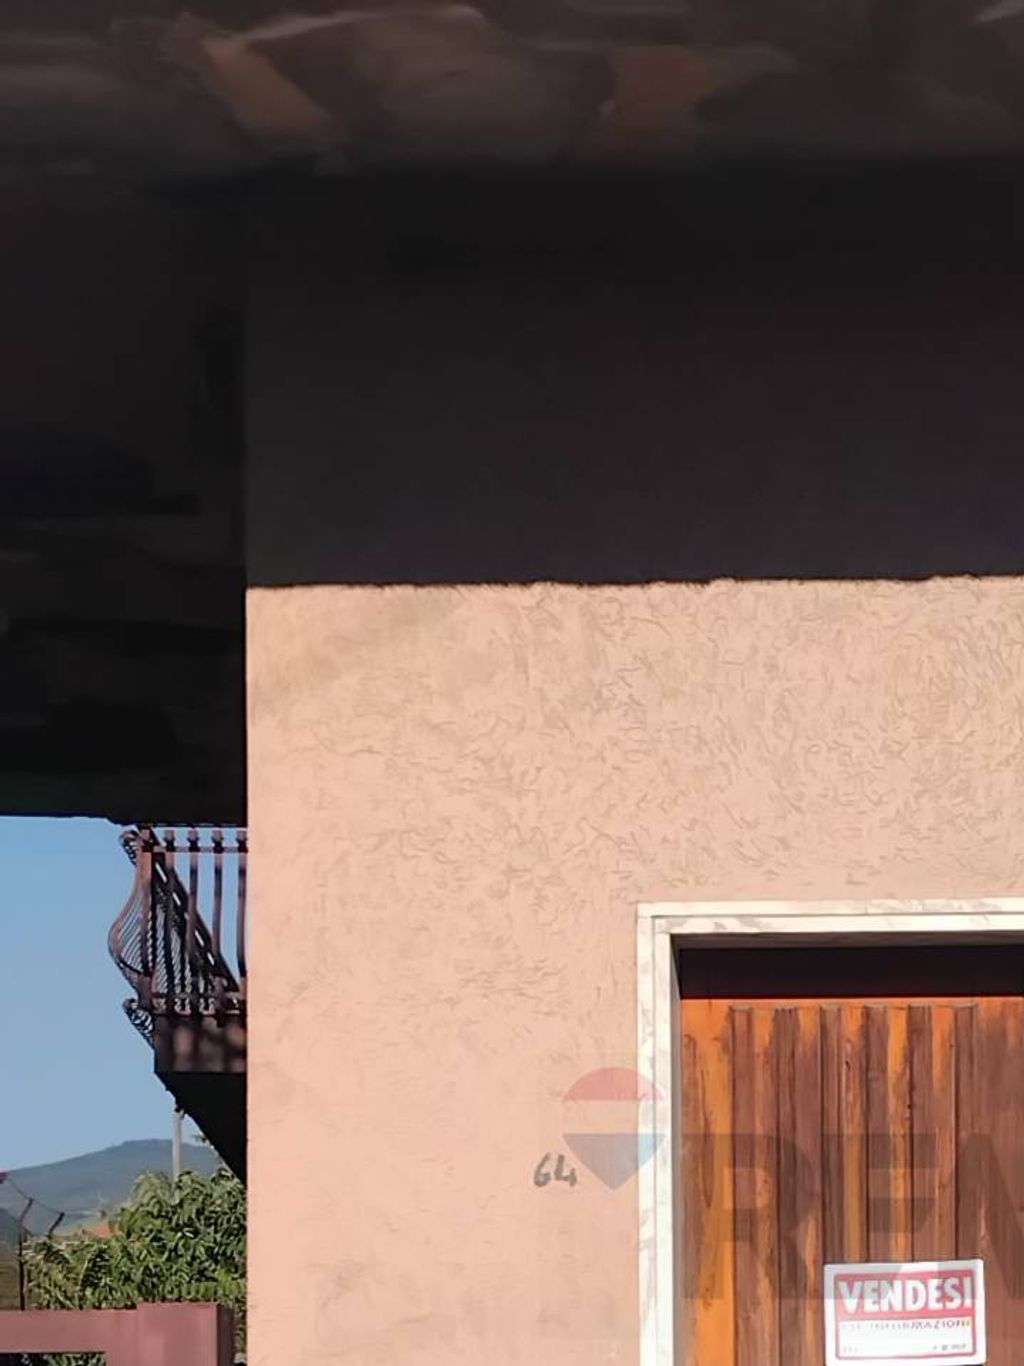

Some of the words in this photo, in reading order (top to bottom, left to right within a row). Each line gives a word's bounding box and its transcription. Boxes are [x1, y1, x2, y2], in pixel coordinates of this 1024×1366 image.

[533, 1152, 578, 1188] 64
[837, 1276, 972, 1314] VENDESI
[870, 1319, 970, 1331] IMAZIONI
